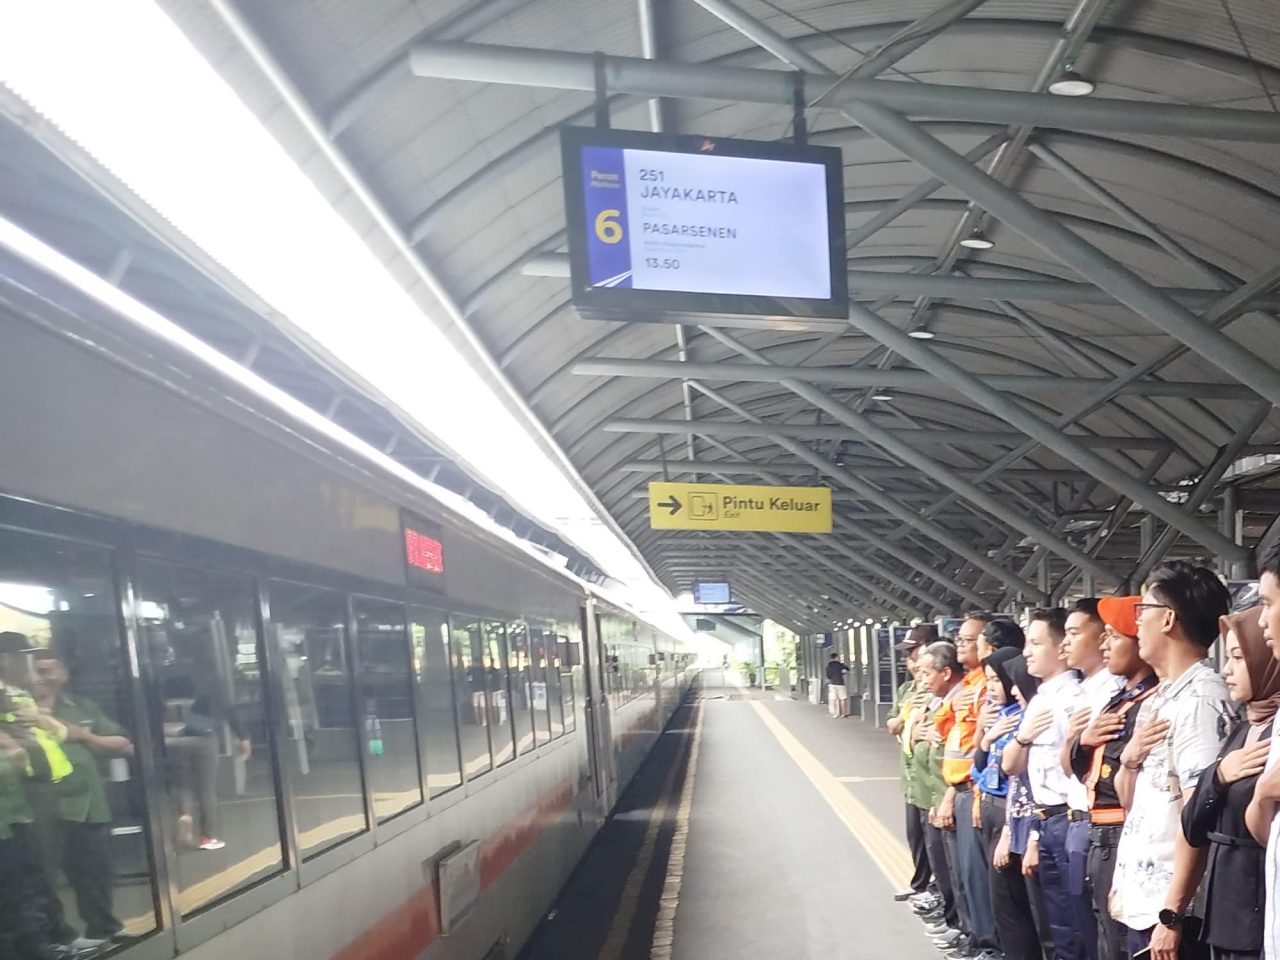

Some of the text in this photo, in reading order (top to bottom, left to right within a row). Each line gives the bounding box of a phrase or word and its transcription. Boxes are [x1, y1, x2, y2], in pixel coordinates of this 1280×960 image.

[639, 168, 664, 182] 251
[640, 185, 738, 205] JAYAKARTA
[594, 208, 623, 245] 6
[642, 222, 737, 239] PASARSENEN
[645, 257, 680, 270] 13.50
[722, 496, 821, 512] Pintu Keluar
